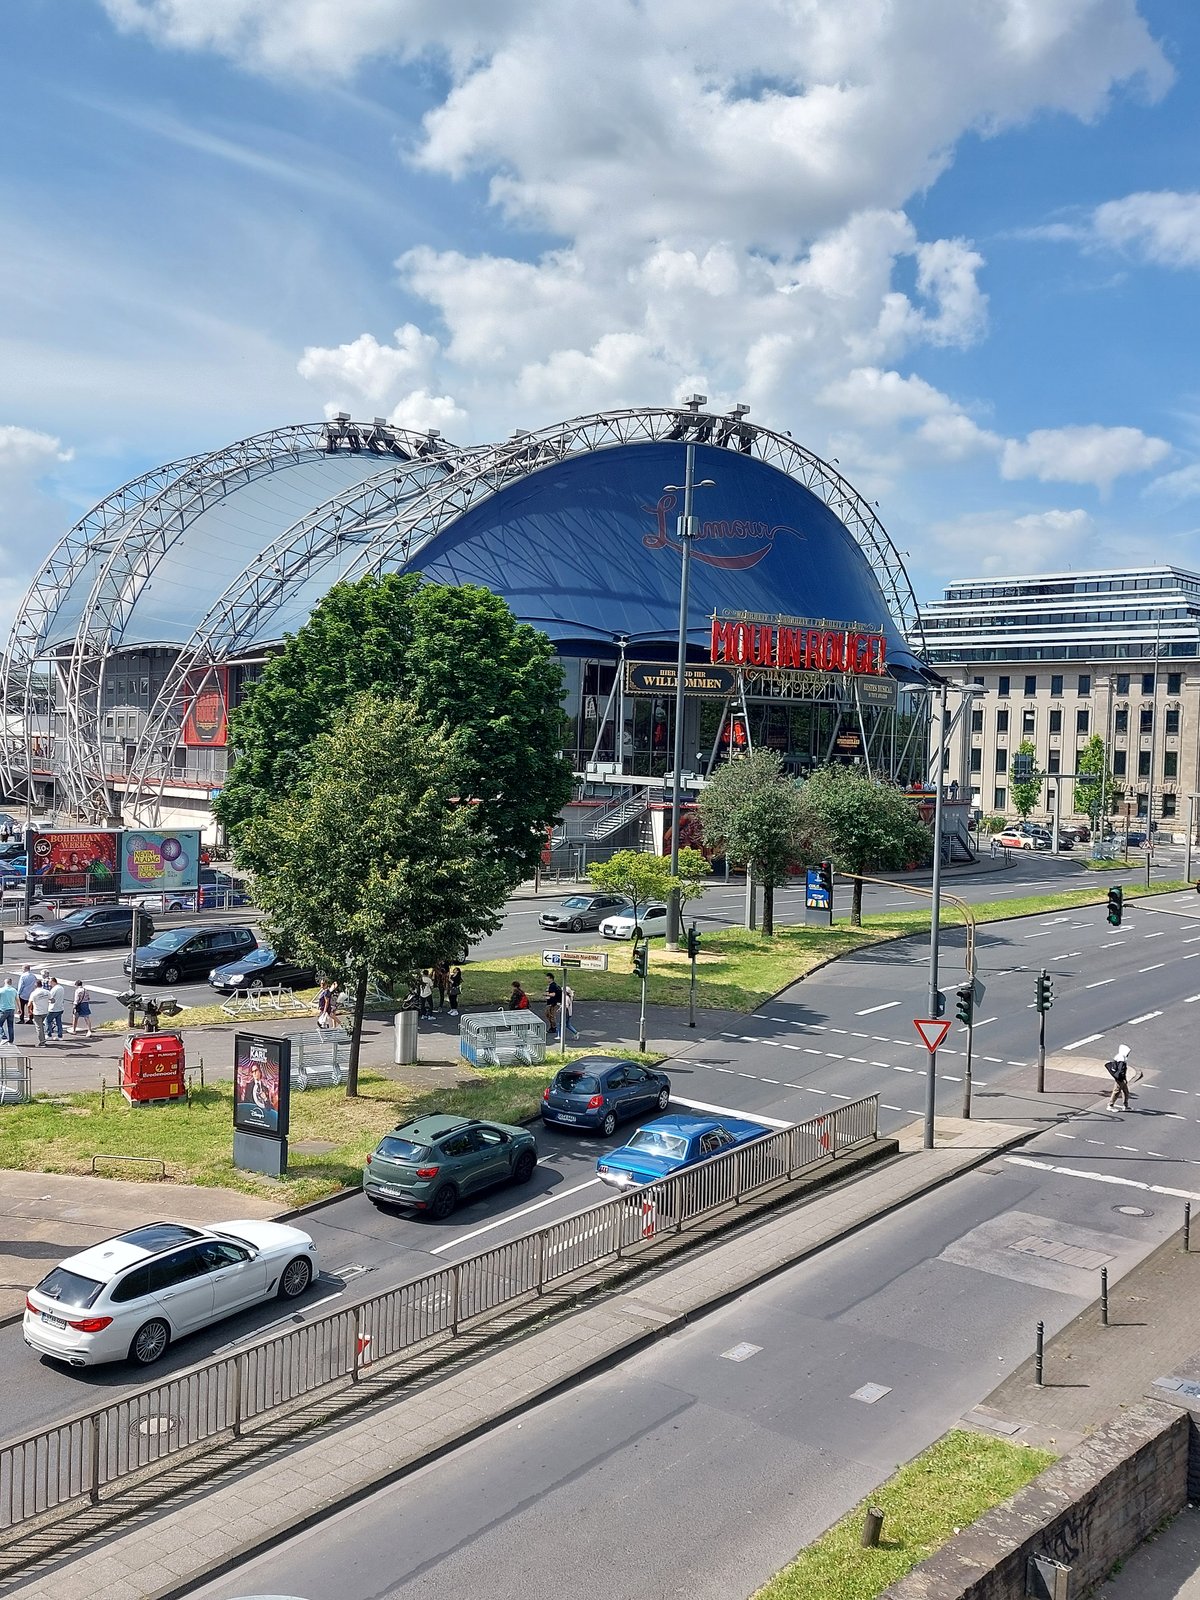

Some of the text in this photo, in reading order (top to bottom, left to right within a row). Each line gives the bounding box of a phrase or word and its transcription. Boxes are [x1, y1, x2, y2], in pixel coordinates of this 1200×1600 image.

[711, 620, 887, 676] MOULIN ROUGE!
[660, 669, 676, 677] HIER
[50, 834, 101, 843] BOHEMIAN
[60, 841, 91, 849] WEEKS
[250, 1050, 267, 1059] KARL
